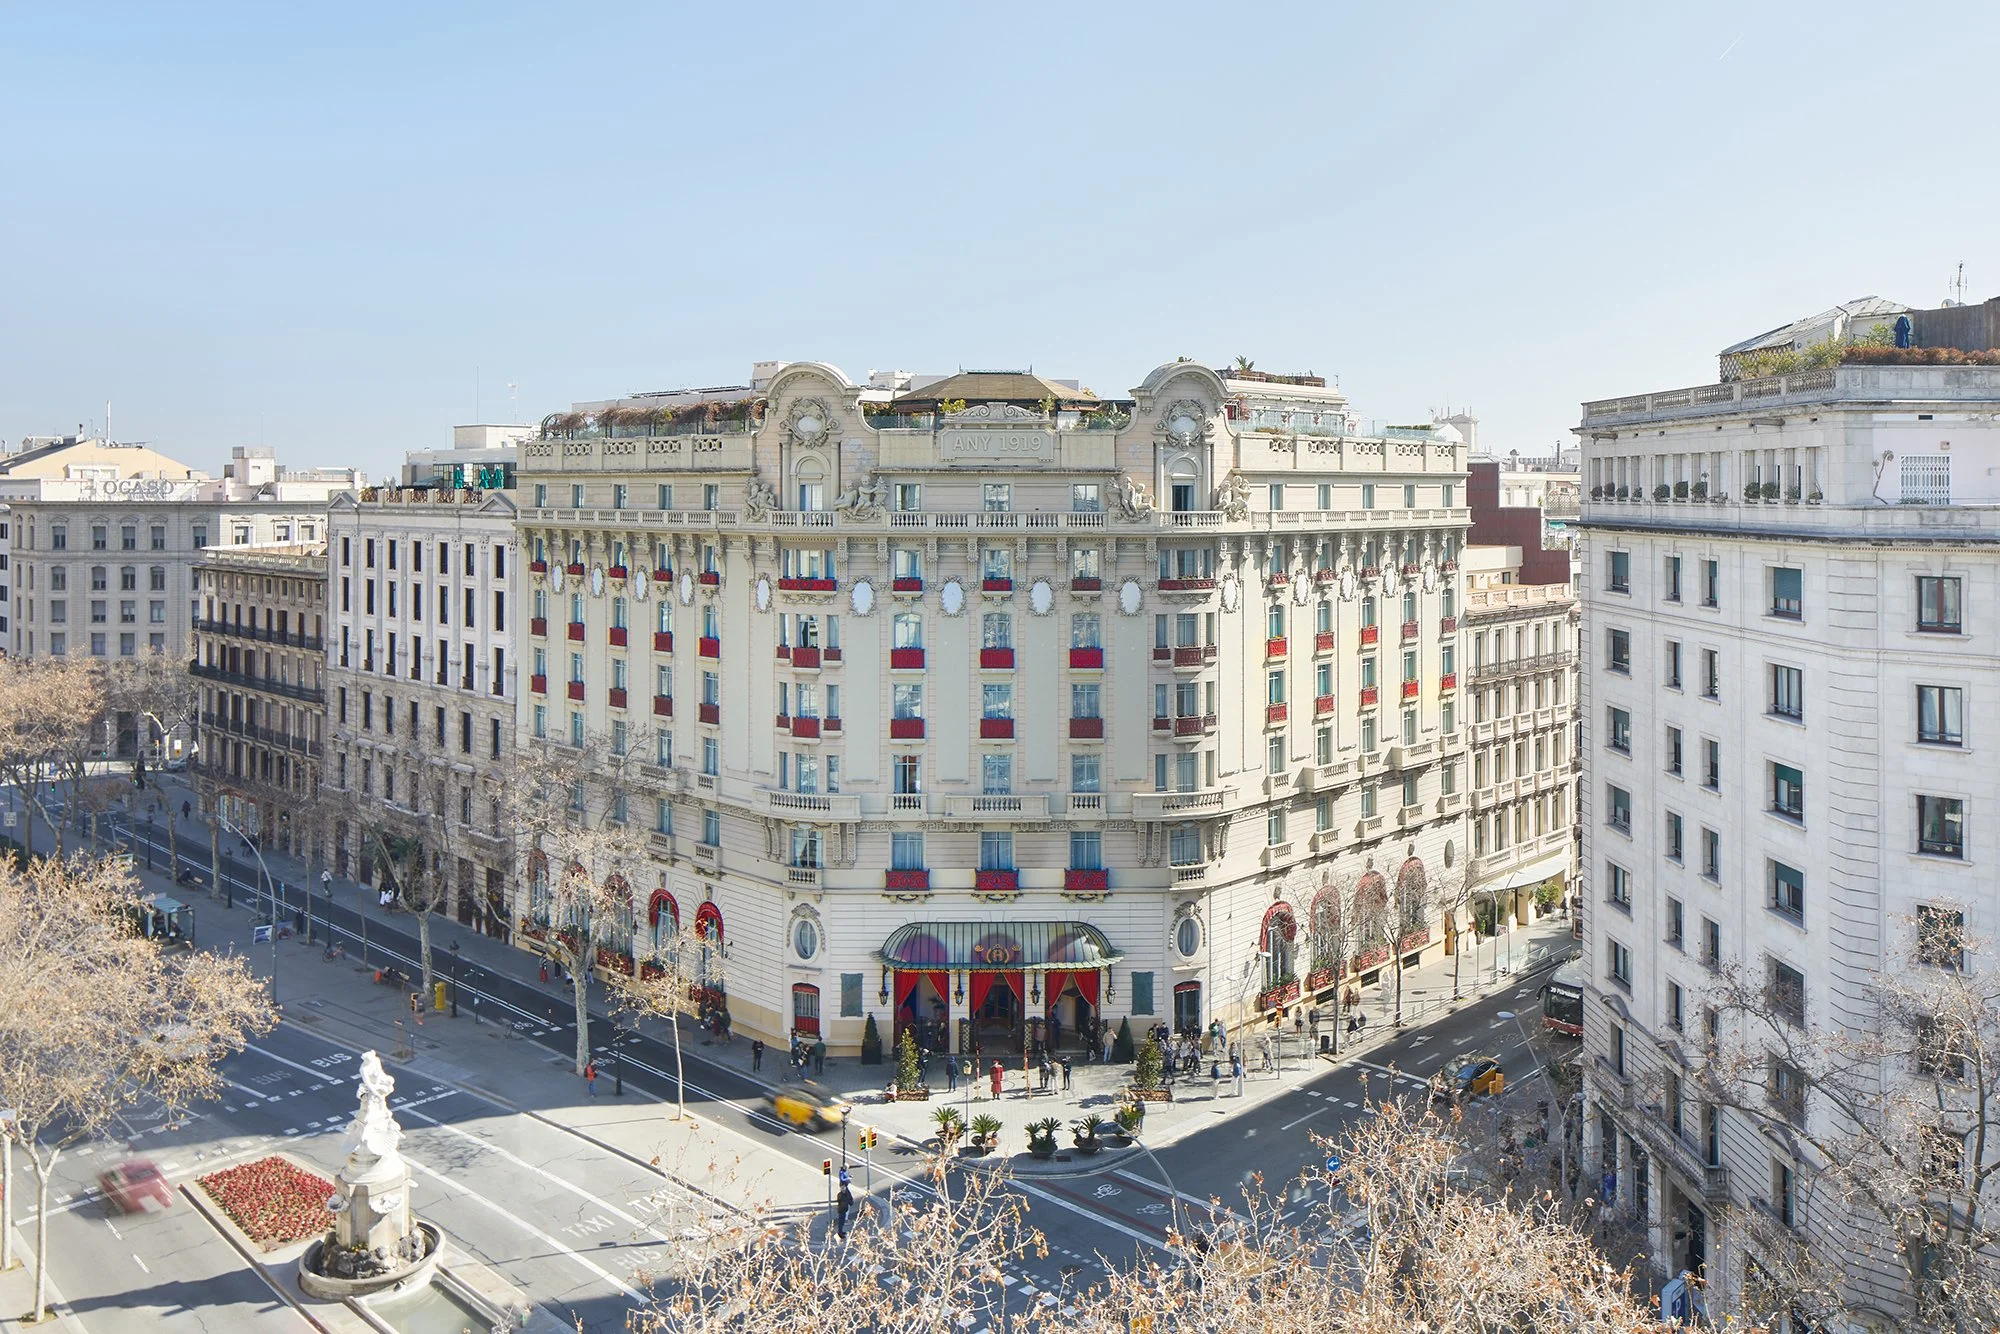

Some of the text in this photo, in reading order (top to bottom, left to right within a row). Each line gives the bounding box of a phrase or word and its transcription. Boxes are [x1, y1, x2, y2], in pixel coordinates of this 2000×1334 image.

[953, 435, 1042, 451] ANY 1919
[103, 480, 174, 495] OCASO
[311, 1053, 352, 1068] BUS
[250, 1070, 292, 1085] BUS
[561, 1215, 616, 1239] TAXI
[612, 1246, 662, 1270] BUS
